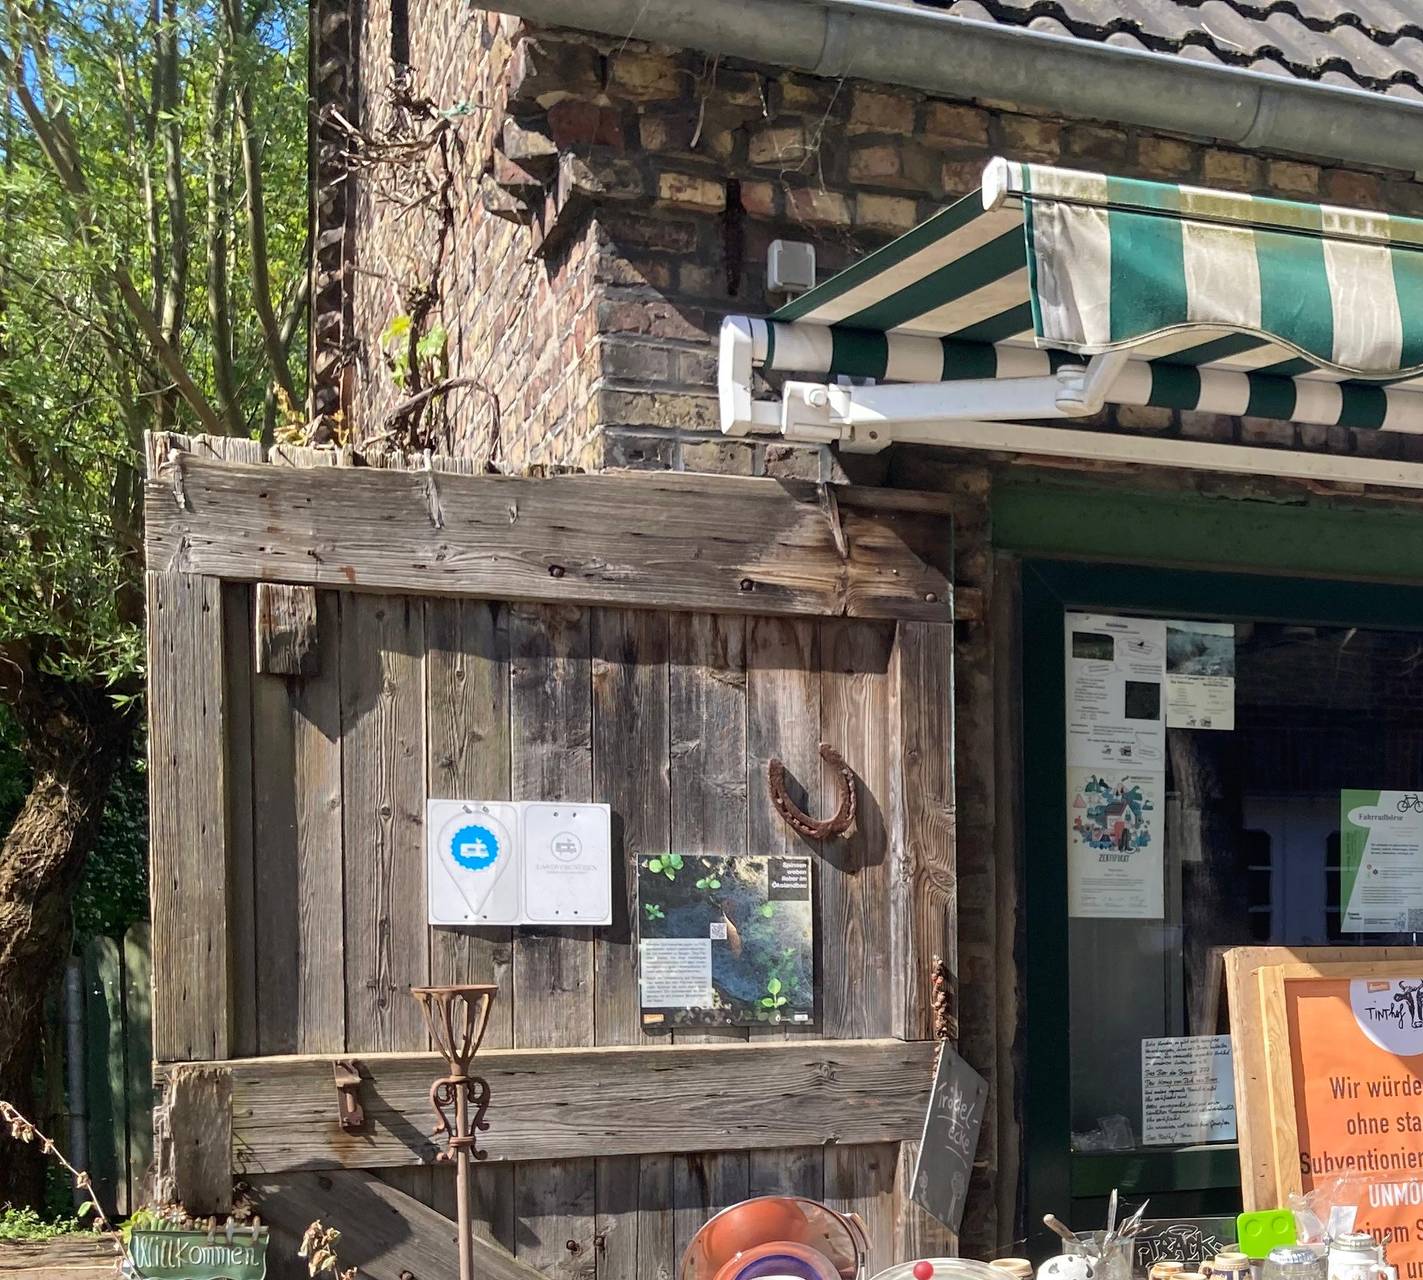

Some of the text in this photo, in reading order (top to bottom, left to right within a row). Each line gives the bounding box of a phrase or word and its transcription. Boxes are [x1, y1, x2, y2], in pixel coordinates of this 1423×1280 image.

[1329, 1076, 1360, 1100] Wir
[1347, 1111, 1389, 1136] ohne
[133, 1235, 260, 1269] Willkommen
